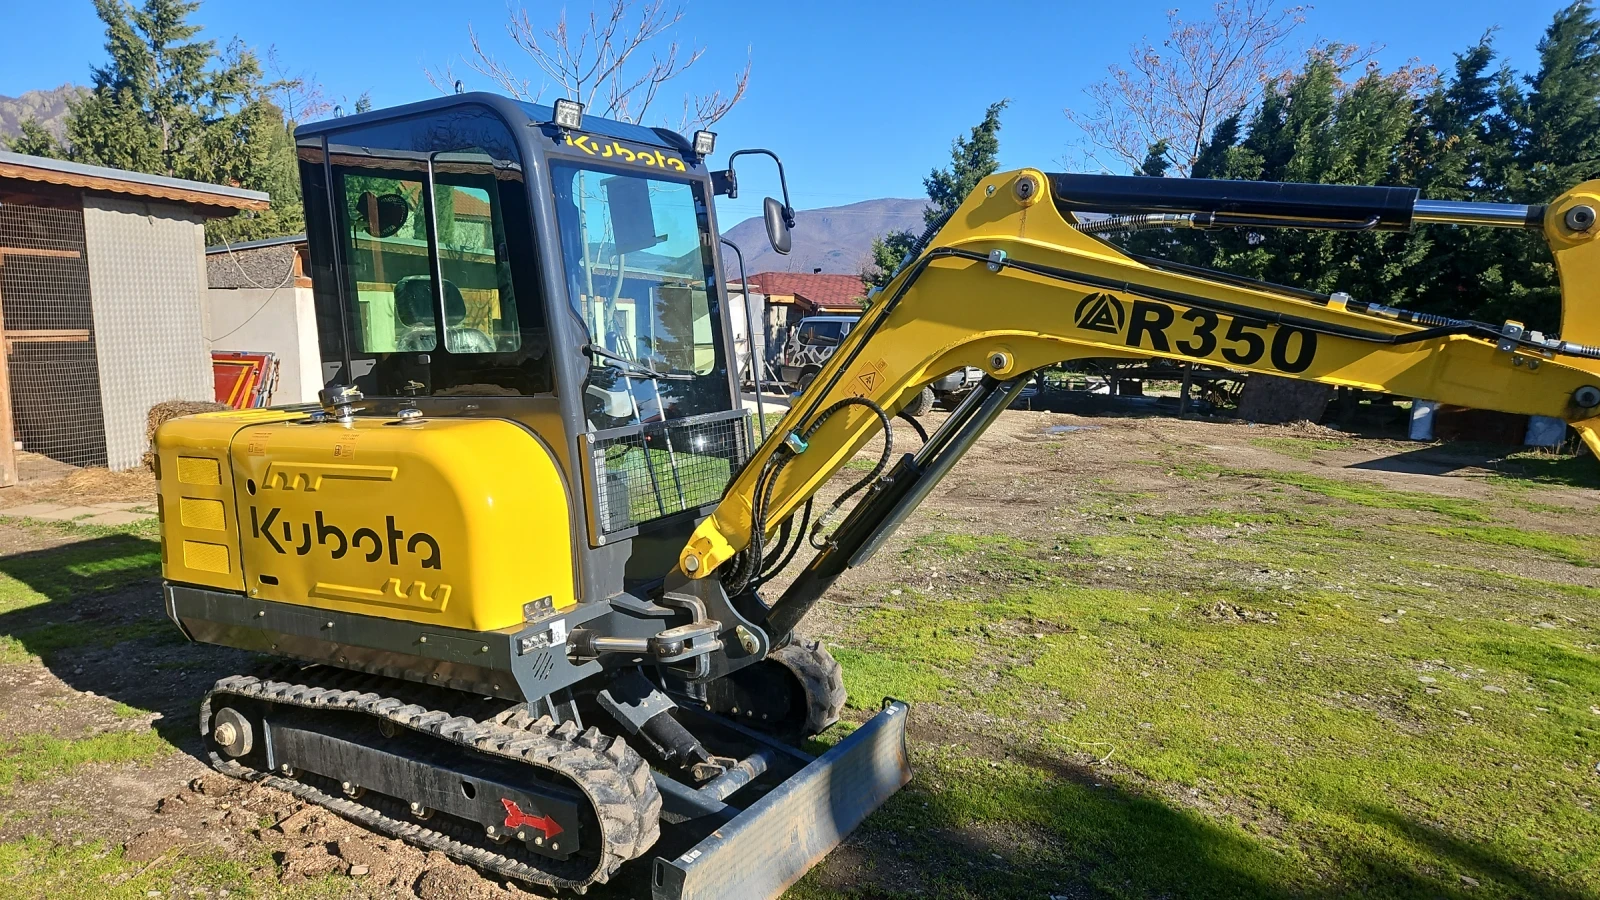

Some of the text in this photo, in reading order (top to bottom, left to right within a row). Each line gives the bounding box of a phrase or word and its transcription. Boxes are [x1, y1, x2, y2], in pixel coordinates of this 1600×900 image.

[565, 134, 687, 172] Kubota
[1125, 299, 1318, 374] R350
[249, 506, 442, 570] Kubota
